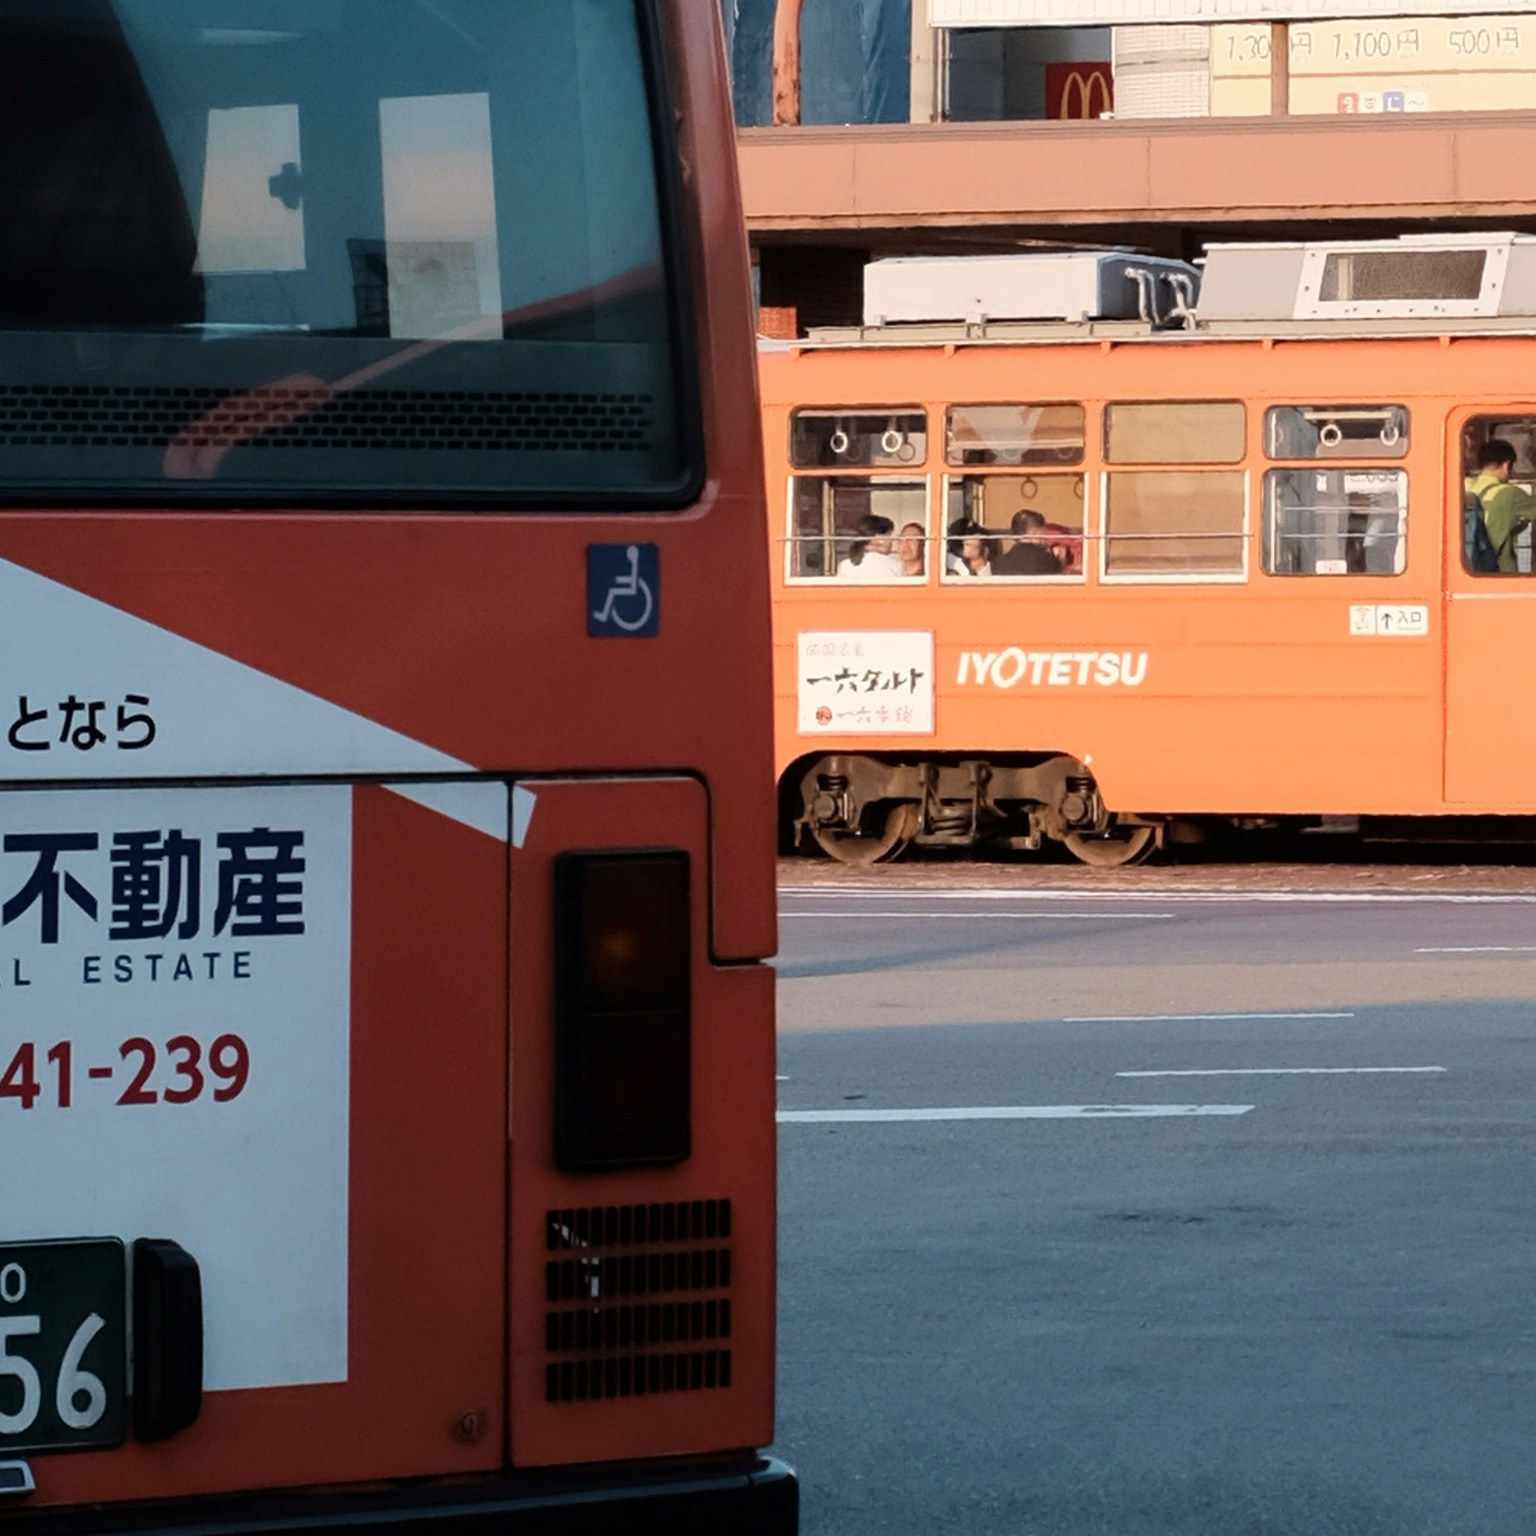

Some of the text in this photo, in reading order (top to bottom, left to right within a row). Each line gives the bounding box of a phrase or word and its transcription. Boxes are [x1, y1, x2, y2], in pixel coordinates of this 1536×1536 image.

[1450, 26, 1519, 56] 500円
[1397, 609, 1422, 624] 入口
[806, 666, 925, 695] 一六タルト
[957, 647, 1149, 688] IYOTETSU
[7, 694, 158, 751] となら
[1, 827, 307, 945] 不動産
[83, 951, 252, 985] ESTATE
[0, 1033, 250, 1110] 41-239
